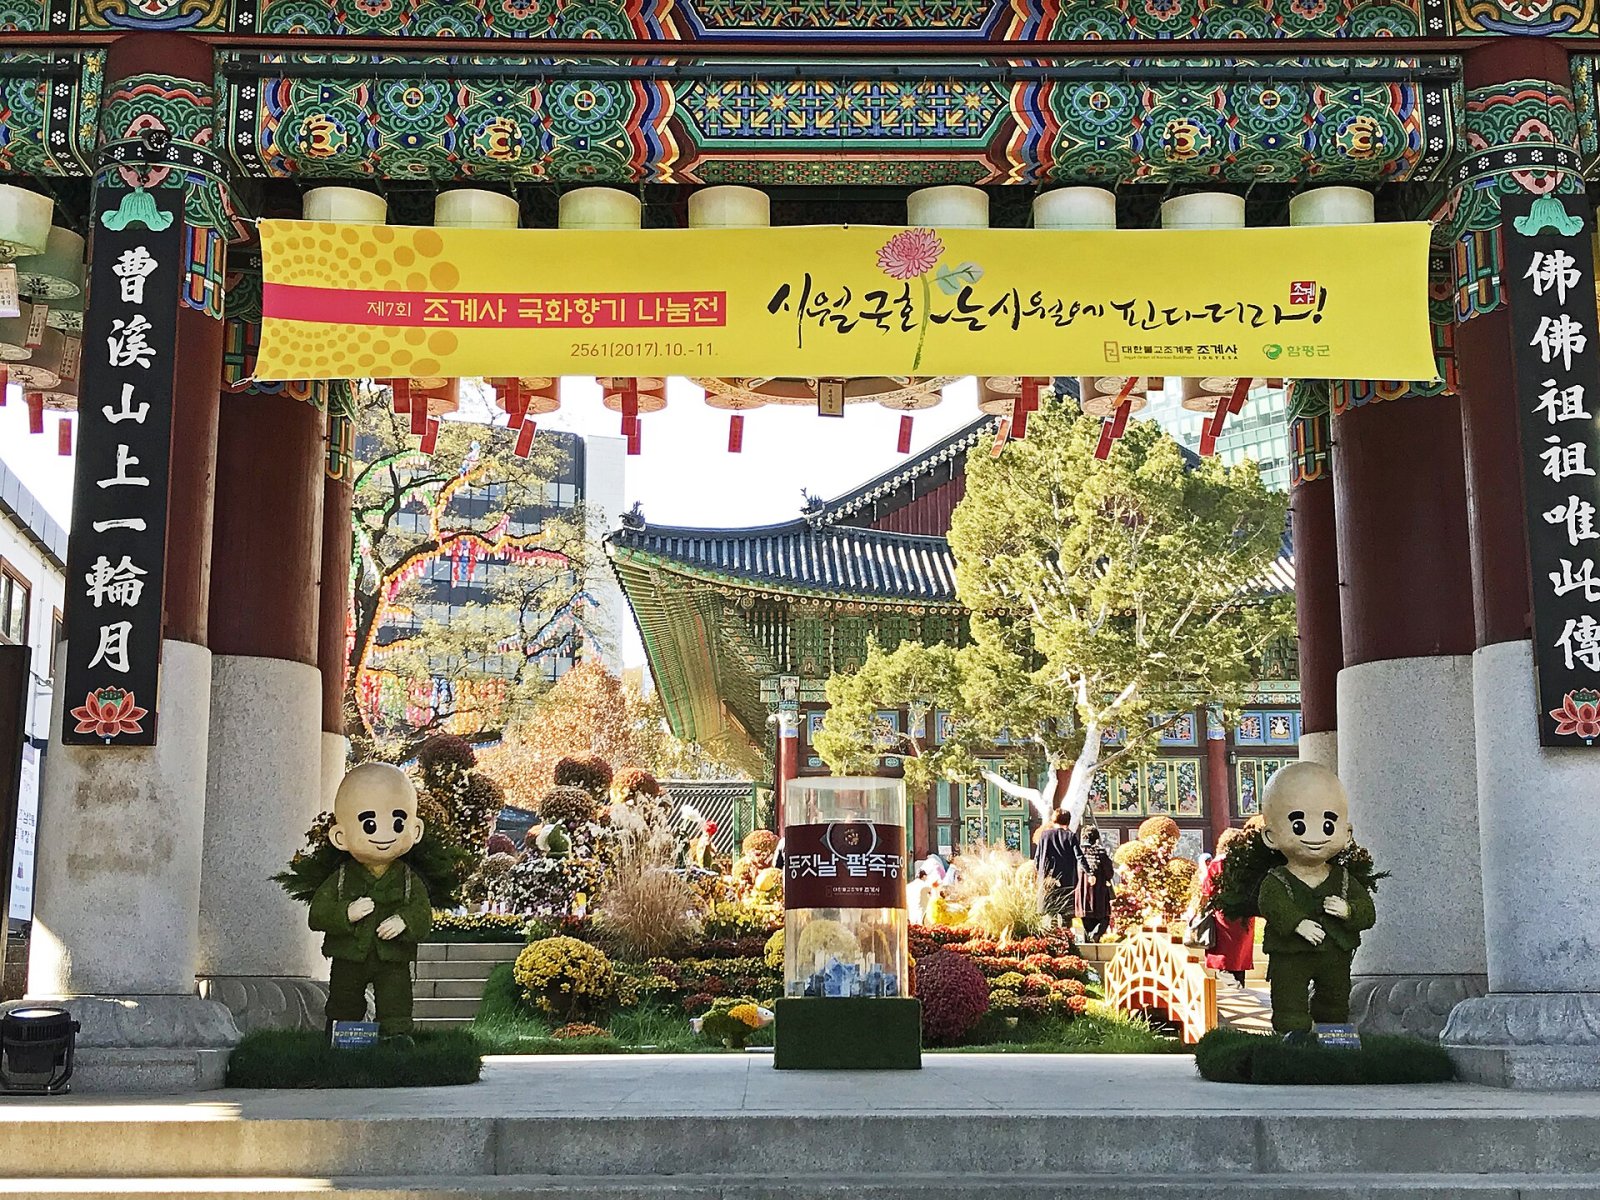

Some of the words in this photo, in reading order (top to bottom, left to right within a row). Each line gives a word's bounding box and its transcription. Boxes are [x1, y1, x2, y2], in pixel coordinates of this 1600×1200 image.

[367, 301, 411, 317] 제7회
[423, 298, 507, 323] 조계사
[518, 298, 625, 324] 국화향기
[638, 296, 718, 323] 나눔전
[1196, 344, 1238, 354] 조계사
[1286, 345, 1330, 357] 함평군
[788, 854, 839, 879] 동짓날
